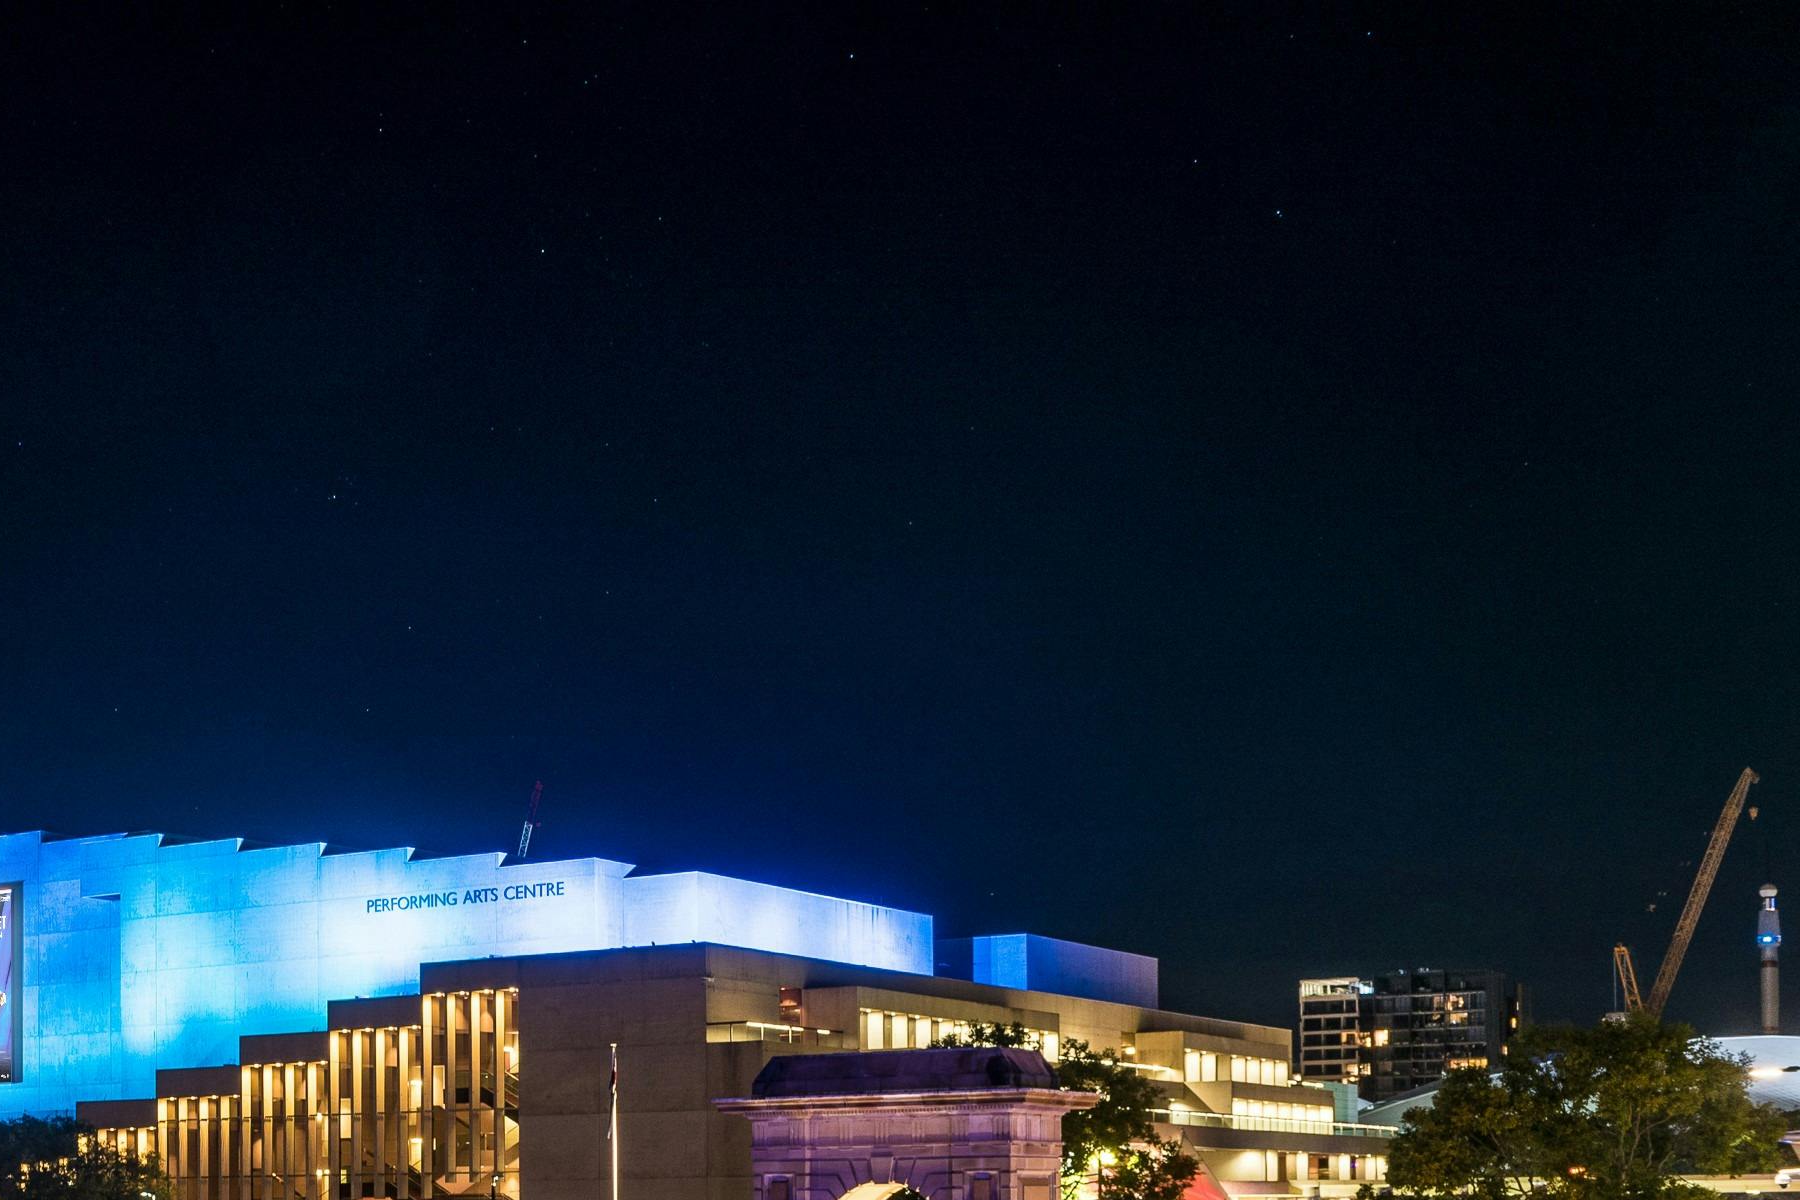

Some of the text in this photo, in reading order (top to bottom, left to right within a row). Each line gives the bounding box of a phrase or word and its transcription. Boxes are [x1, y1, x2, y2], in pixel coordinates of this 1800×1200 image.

[366, 881, 565, 913] PERFORMING ARTS CENTRE
